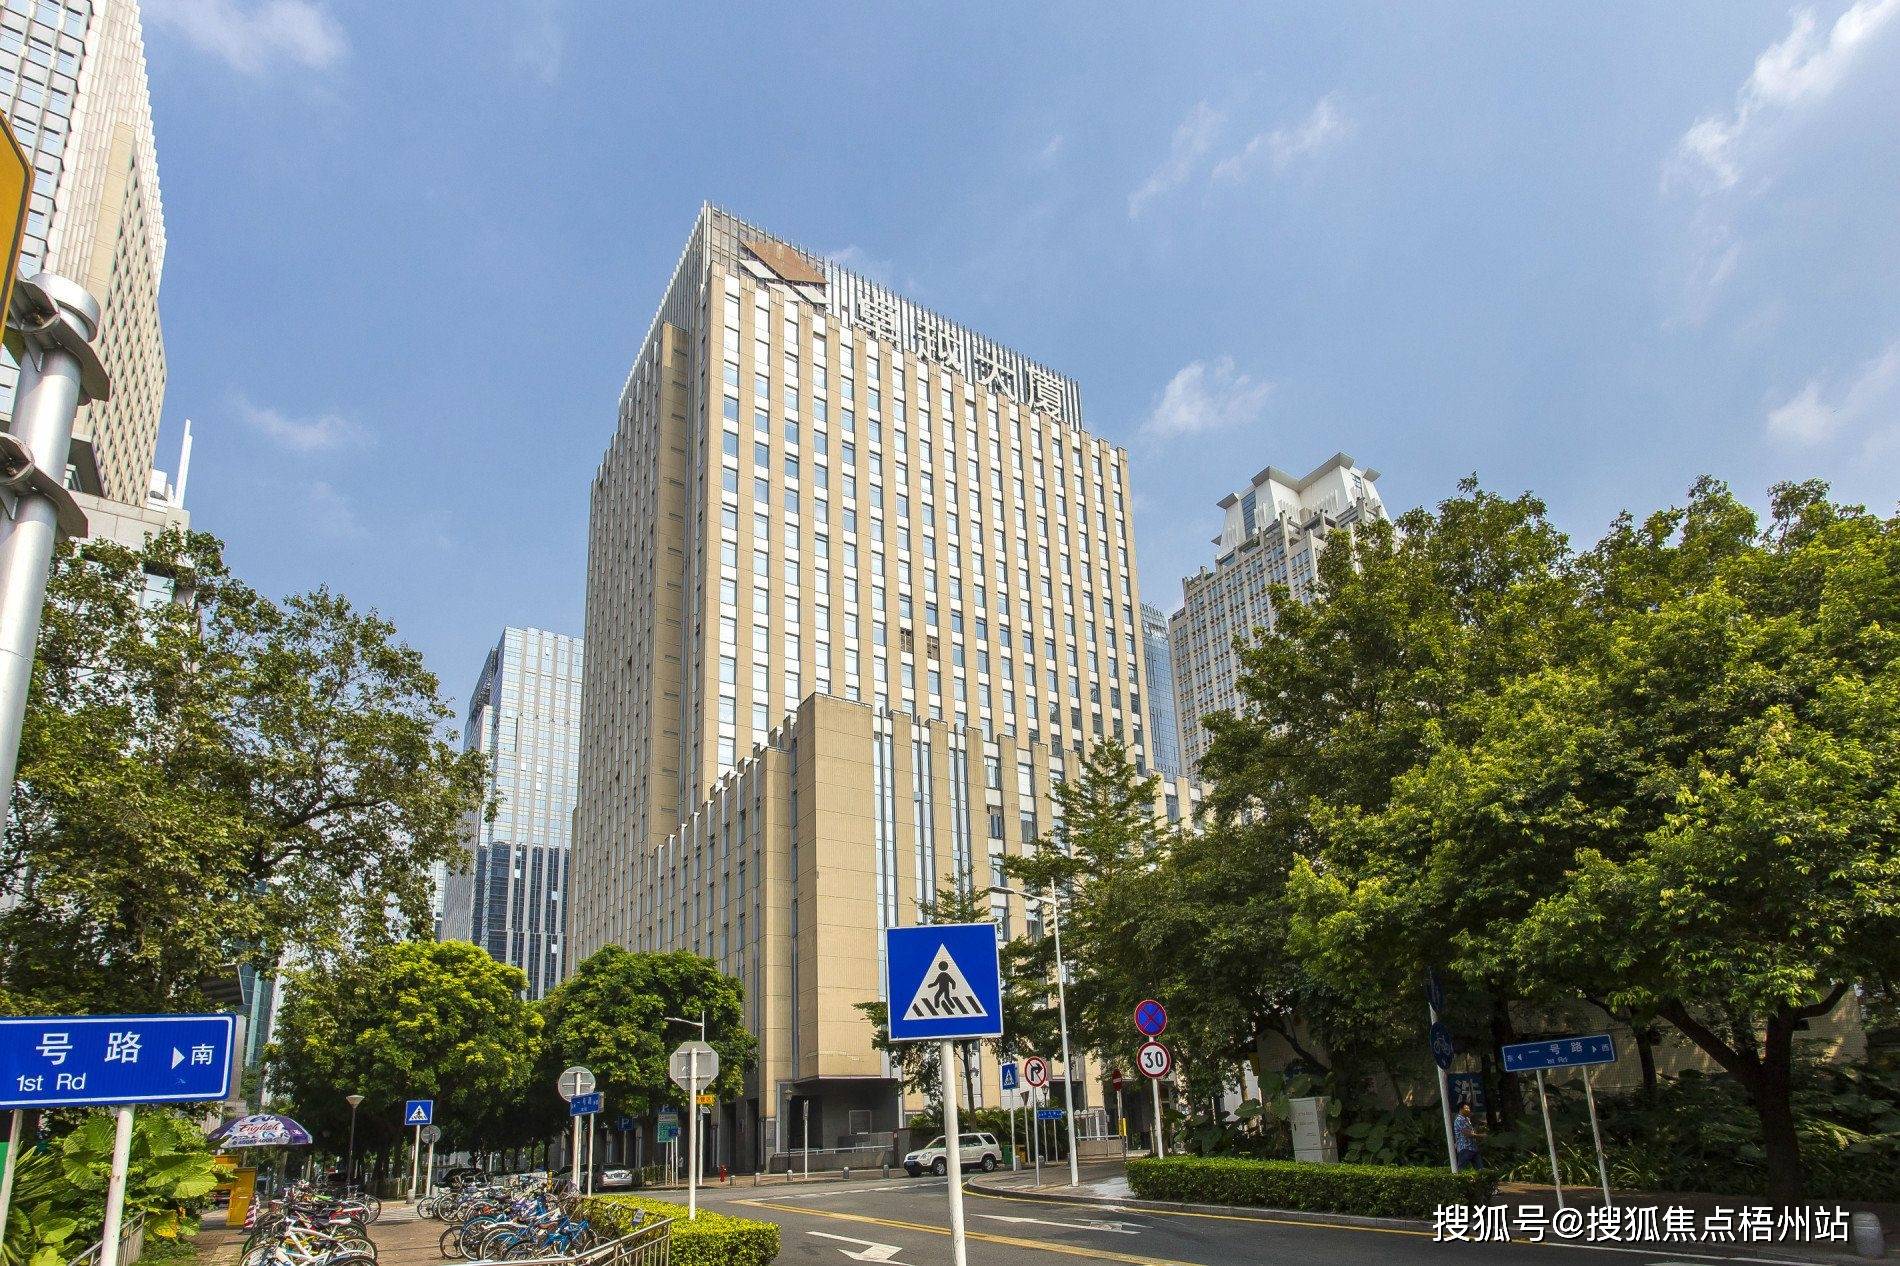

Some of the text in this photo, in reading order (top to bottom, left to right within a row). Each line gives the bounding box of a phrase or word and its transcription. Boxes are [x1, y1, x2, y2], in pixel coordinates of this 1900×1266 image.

[190, 1044, 215, 1066] 南
[1144, 1052, 1164, 1069] 30
[16, 1073, 87, 1092] 1st Rd
[239, 1123, 279, 1133] English
